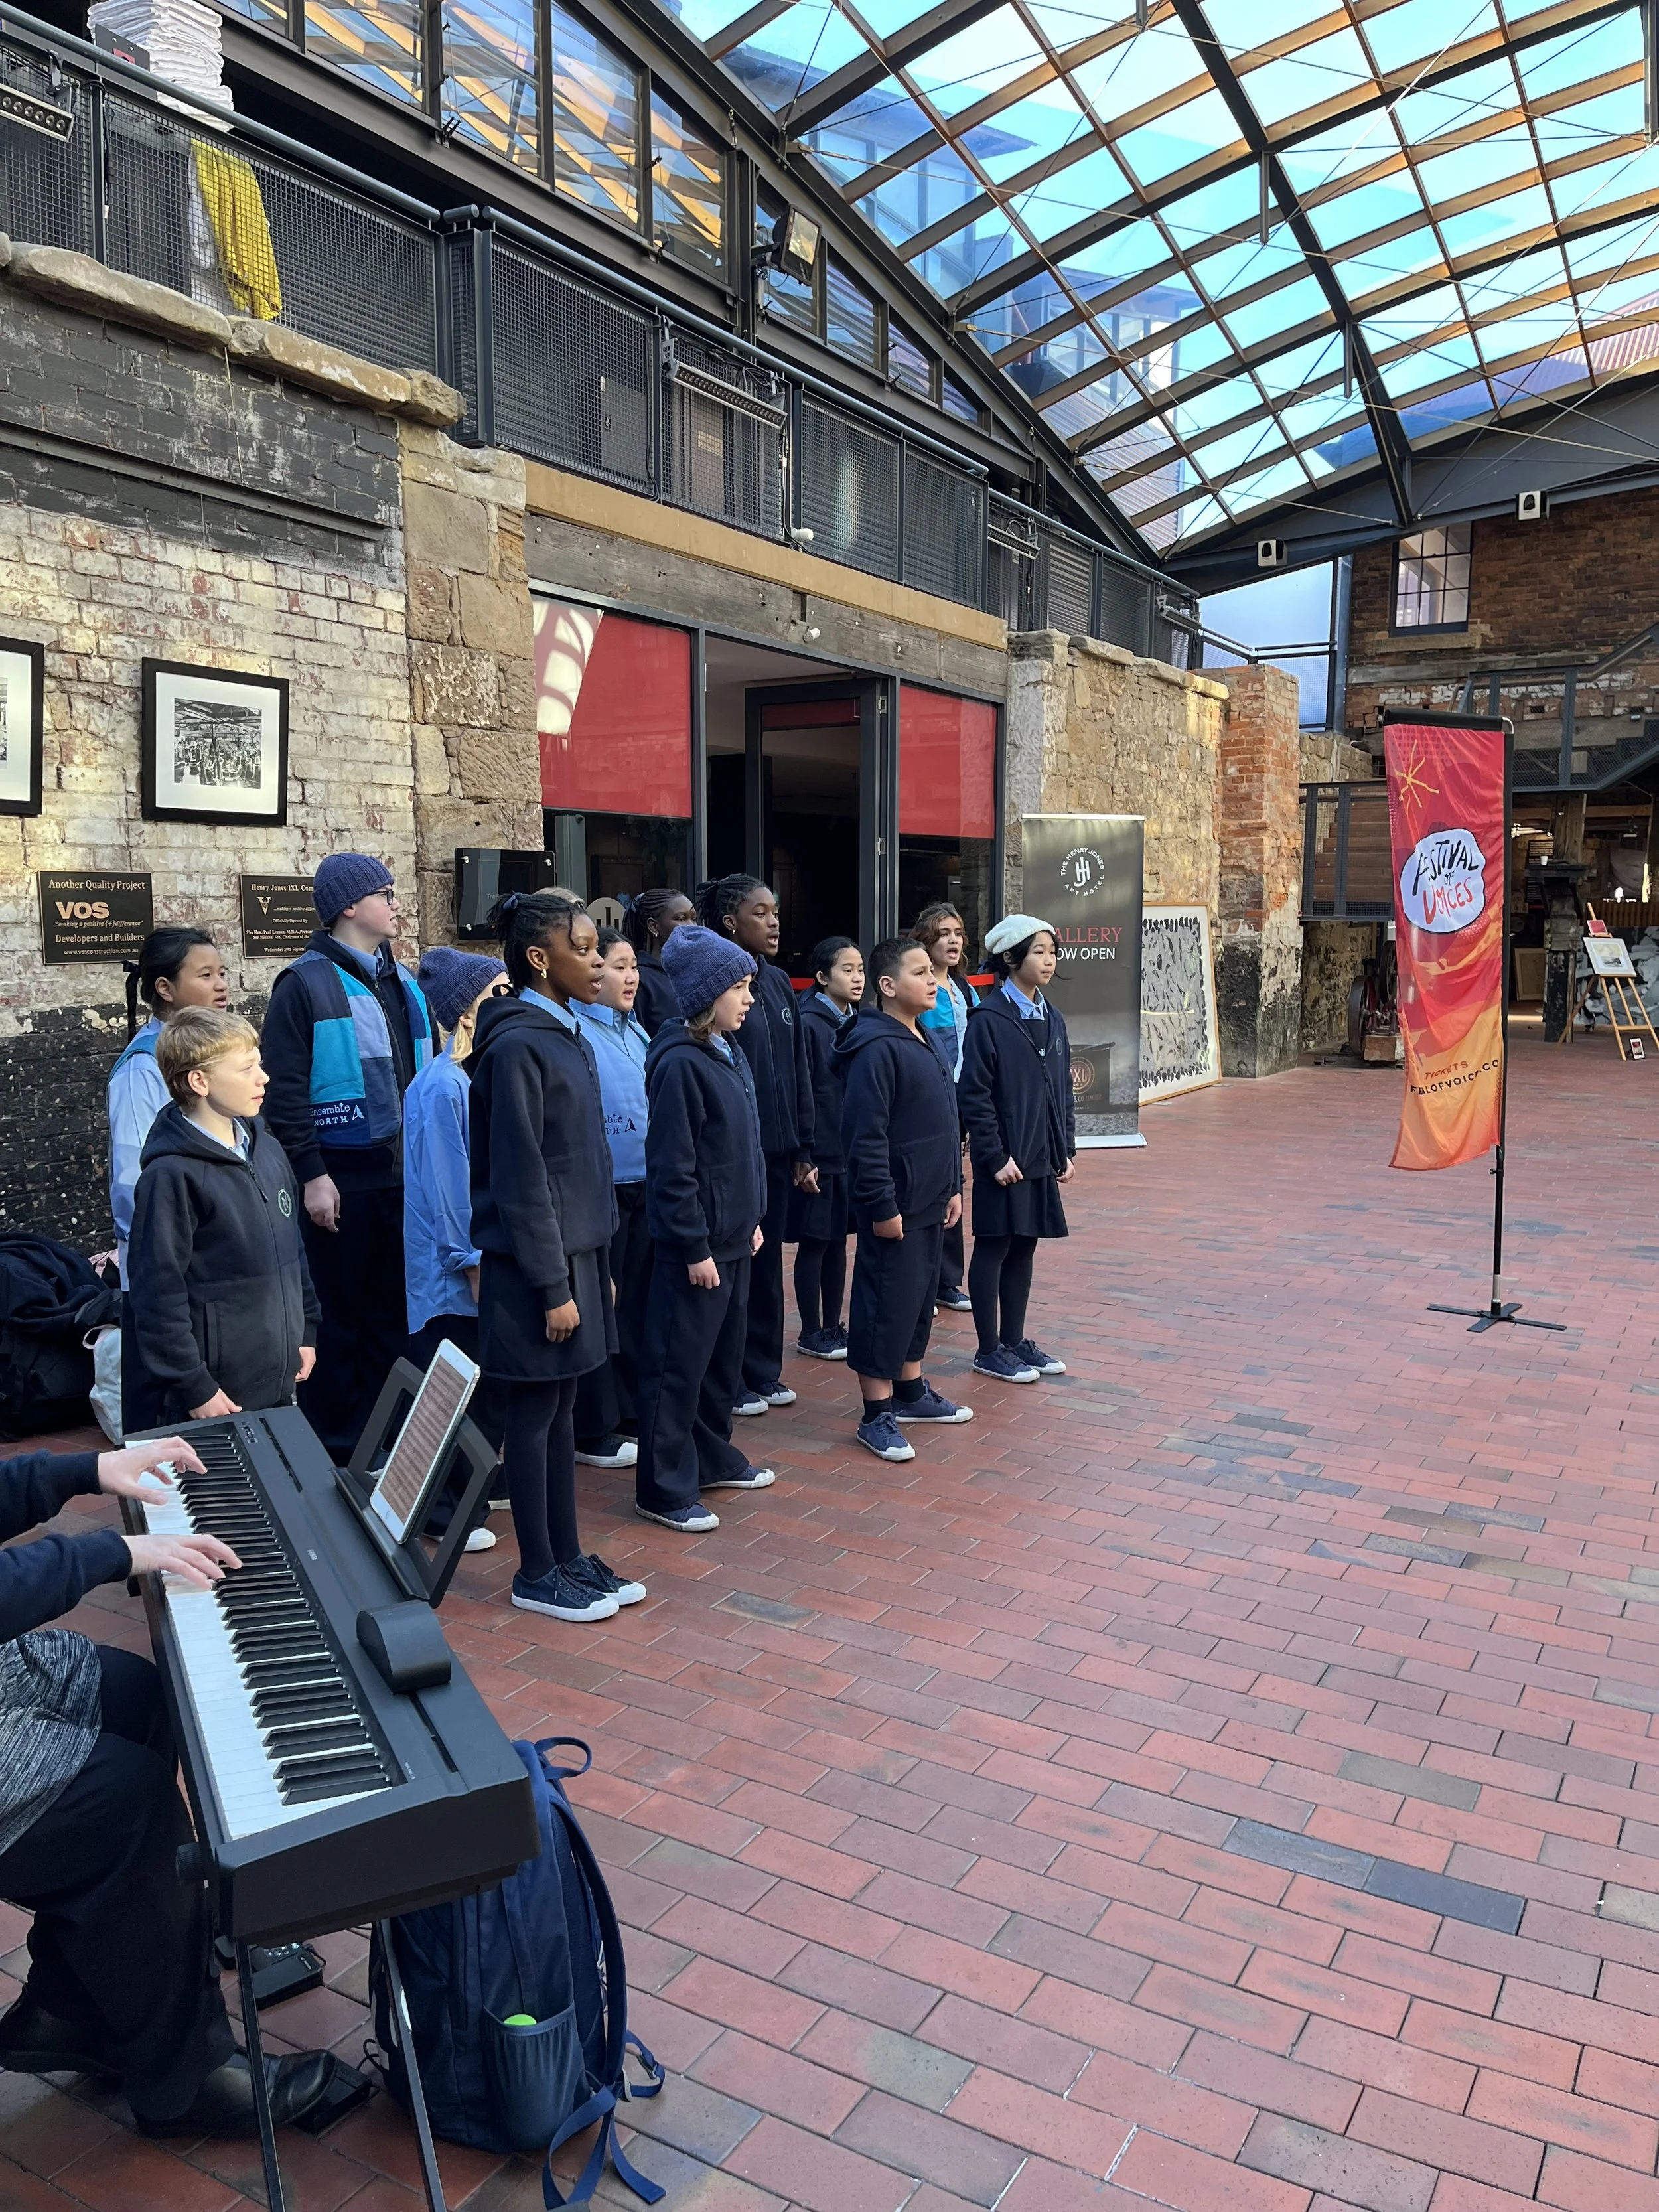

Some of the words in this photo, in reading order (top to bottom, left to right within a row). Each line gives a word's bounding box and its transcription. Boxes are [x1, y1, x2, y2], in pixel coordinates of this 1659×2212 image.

[1066, 847, 1088, 861] HENRY
[1088, 849, 1105, 870] JONES
[1412, 840, 1479, 896] FESTIVAL
[48, 879, 84, 889] Another
[86, 879, 115, 891] Quality
[117, 880, 145, 891] Project
[1064, 883, 1080, 895] ART
[1084, 875, 1104, 896] HOTEL
[1445, 871, 1455, 886] OF
[251, 883, 269, 892] Henry
[1423, 877, 1473, 924] VOICES
[55, 901, 109, 919] VOS
[56, 934, 98, 944] Developers
[115, 933, 145, 942] Builders
[1055, 927, 1123, 942] ALLERY
[1057, 948, 1078, 960] OW
[1080, 947, 1115, 960] OPEN
[1425, 1061, 1469, 1080] TICKETS
[309, 1102, 350, 1116] Ensemble
[314, 1116, 348, 1126] NORTH
